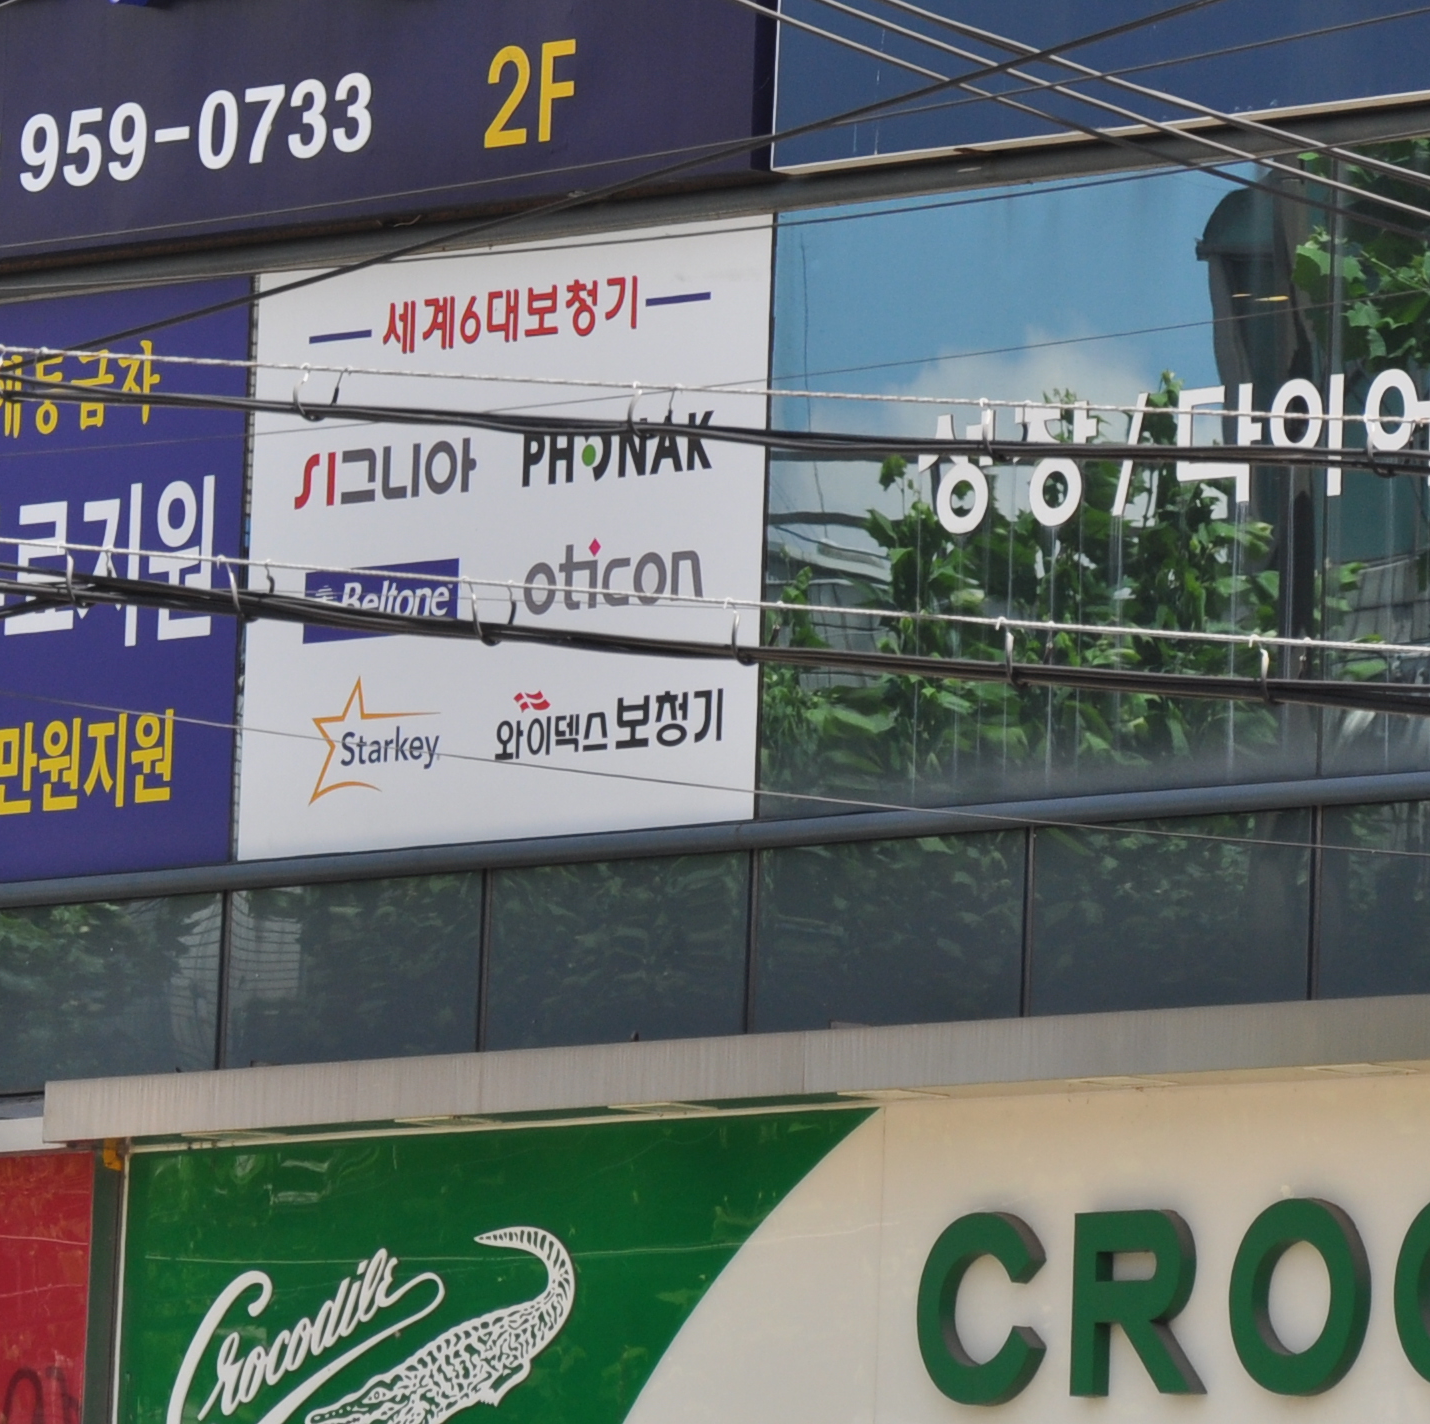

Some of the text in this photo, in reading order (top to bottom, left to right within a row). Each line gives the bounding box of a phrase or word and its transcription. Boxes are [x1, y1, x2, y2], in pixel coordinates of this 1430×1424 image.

[19, 72, 373, 192] 959-0733
[484, 38, 577, 148] 2F
[383, 276, 638, 354] 세계6대보청기
[294, 437, 477, 510] 시그니아
[522, 411, 714, 487] PHONAK
[341, 578, 449, 618] Beltone
[523, 538, 703, 615] oticon
[341, 726, 440, 769] Starkey
